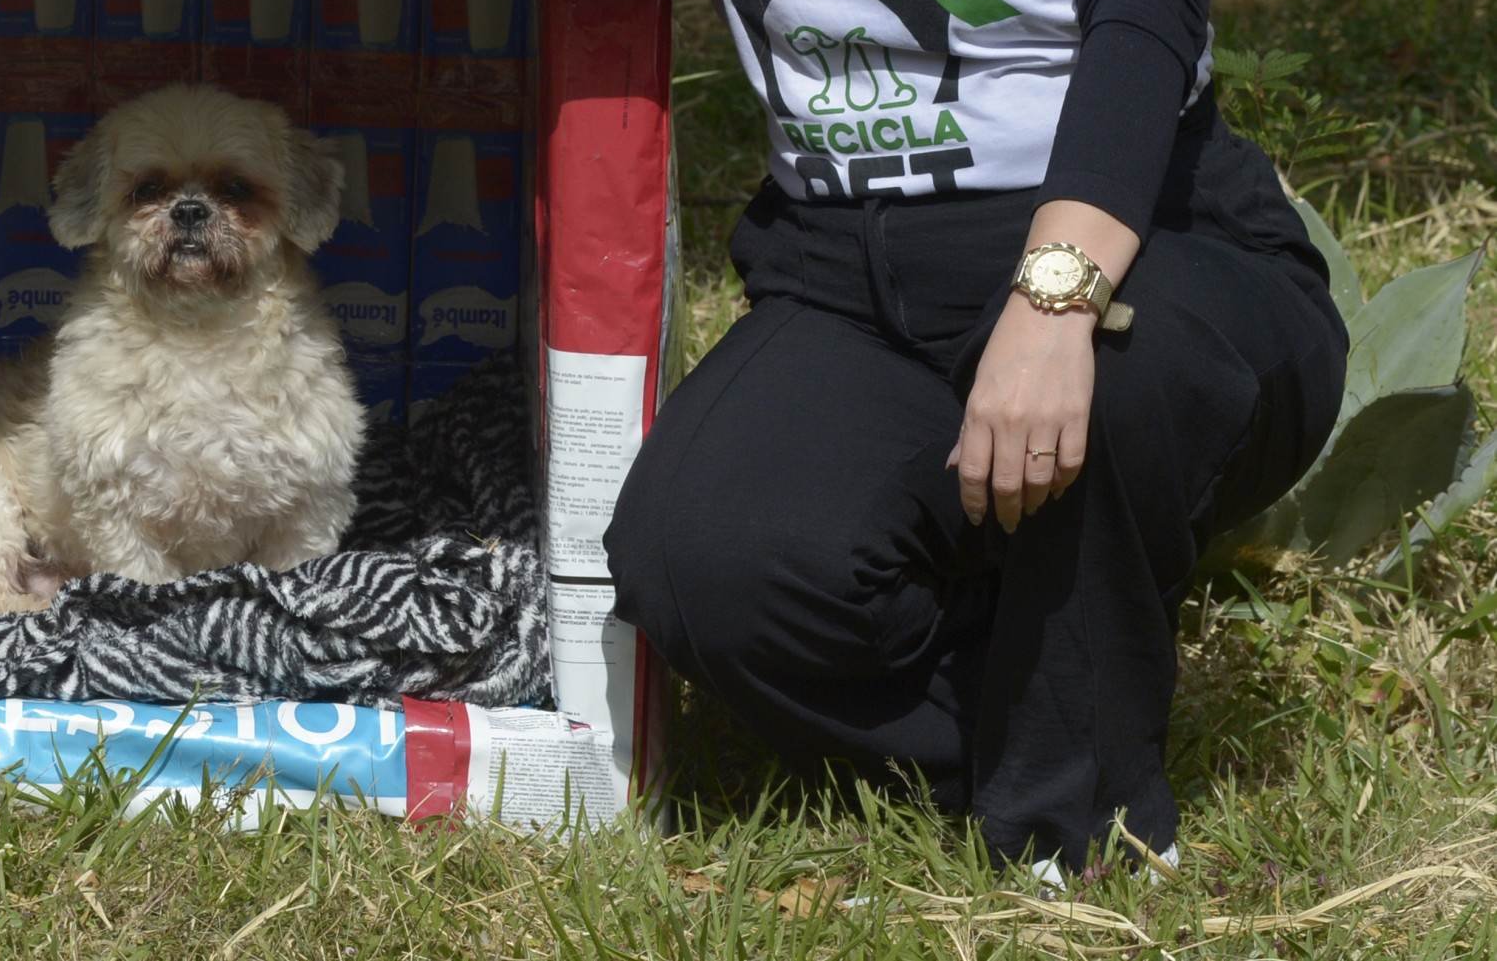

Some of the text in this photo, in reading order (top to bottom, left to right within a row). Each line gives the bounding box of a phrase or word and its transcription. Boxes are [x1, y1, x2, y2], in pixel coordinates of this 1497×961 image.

[781, 109, 968, 153] RECICLA
[7, 288, 64, 311] ambé
[432, 308, 507, 329] itambé
